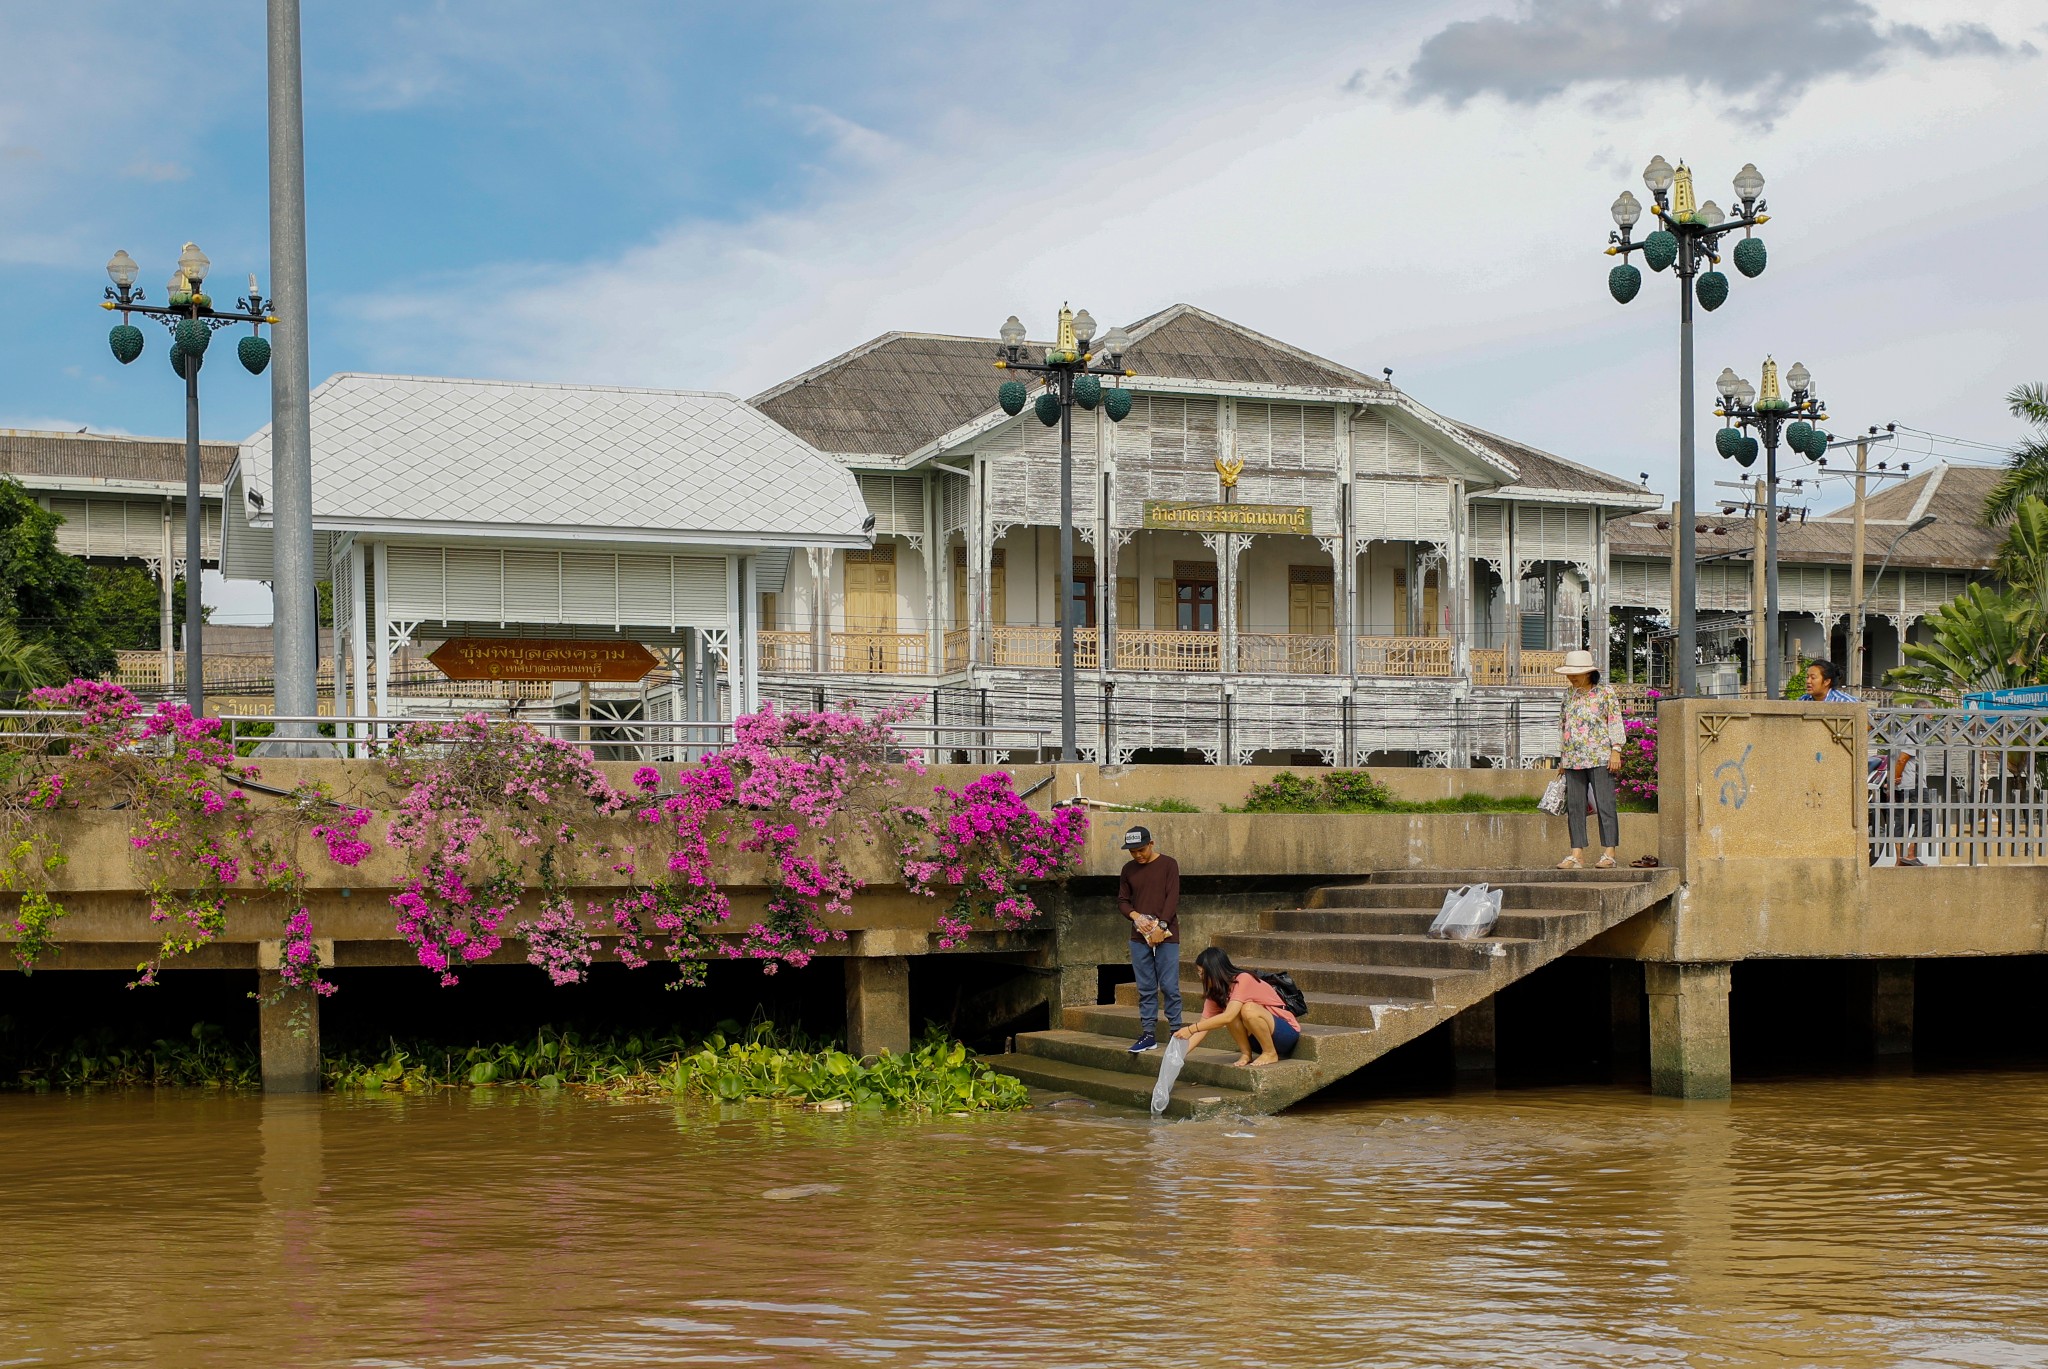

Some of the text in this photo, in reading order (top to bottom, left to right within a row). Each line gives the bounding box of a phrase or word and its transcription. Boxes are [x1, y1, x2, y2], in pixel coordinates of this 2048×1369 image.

[1152, 505, 1305, 532] ศาลากลางจังหวัดนนทบุรี
